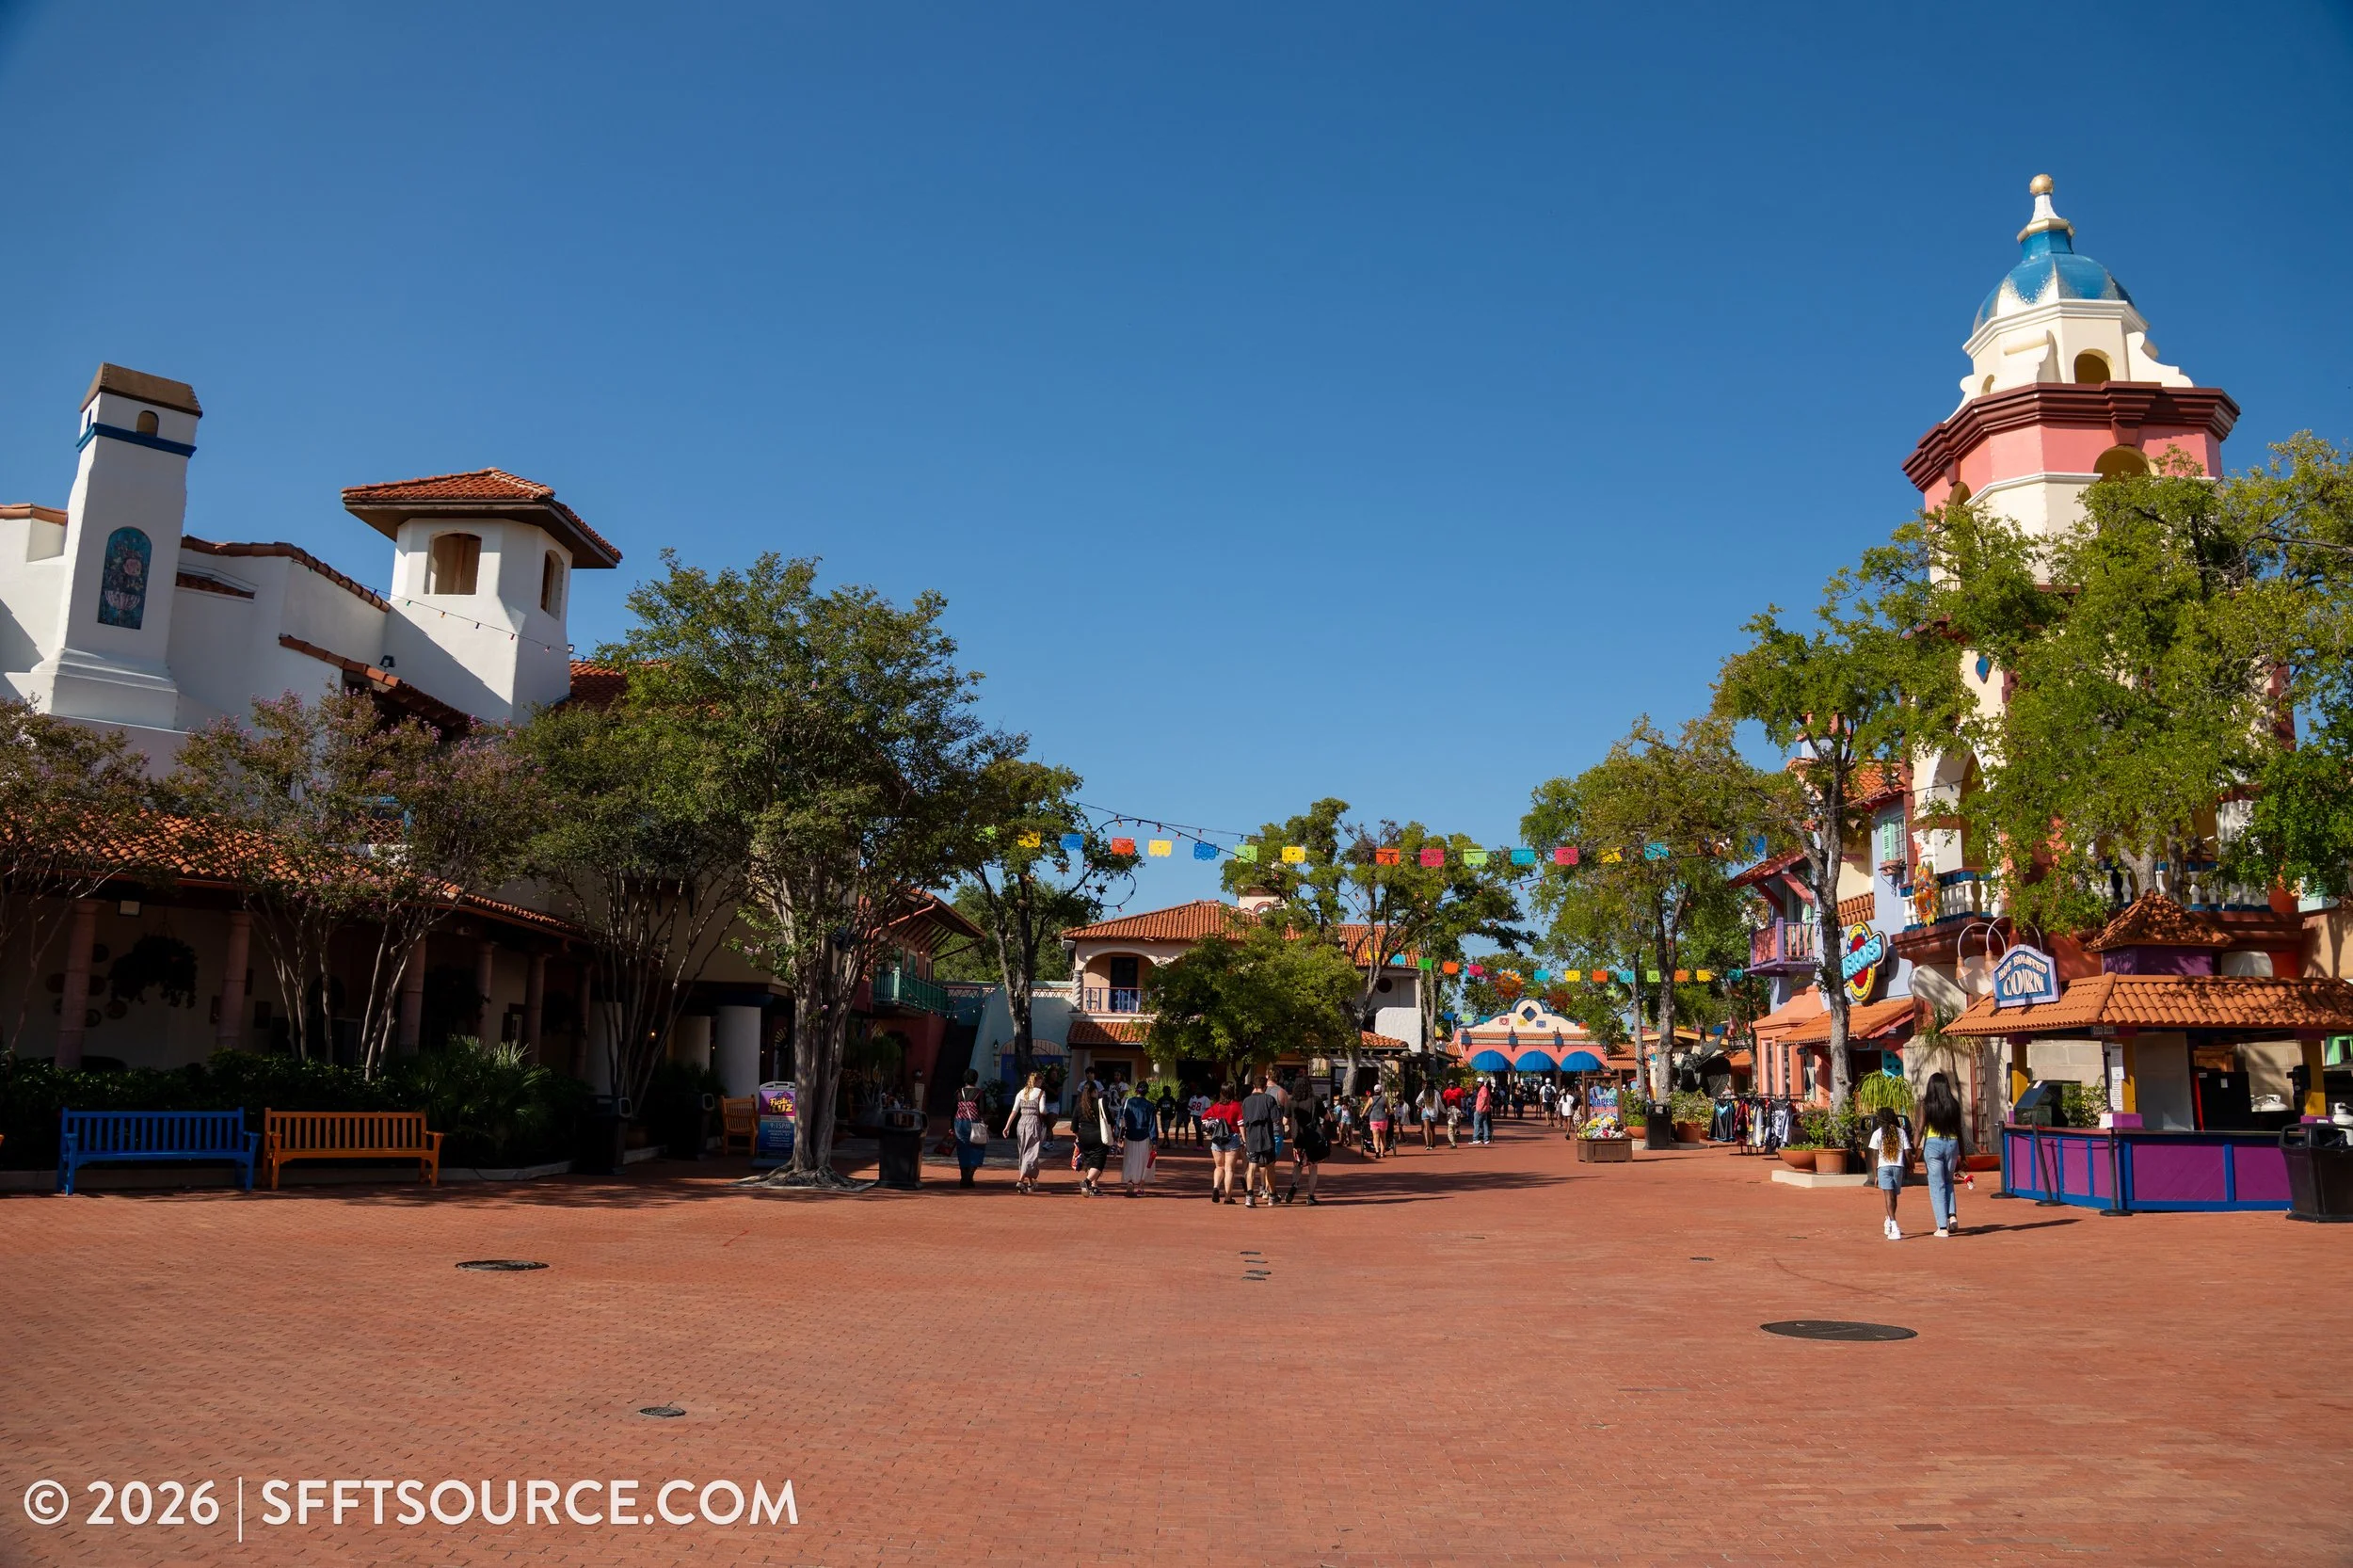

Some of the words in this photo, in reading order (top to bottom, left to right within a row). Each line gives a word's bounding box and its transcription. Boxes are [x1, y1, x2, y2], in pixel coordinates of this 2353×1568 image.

[1842, 936, 1882, 980] EROES
[1998, 961, 2012, 980] HOT
[2013, 954, 2048, 975] ROASTED
[2003, 968, 2045, 996] CORN
[771, 1103, 793, 1113] LUZ
